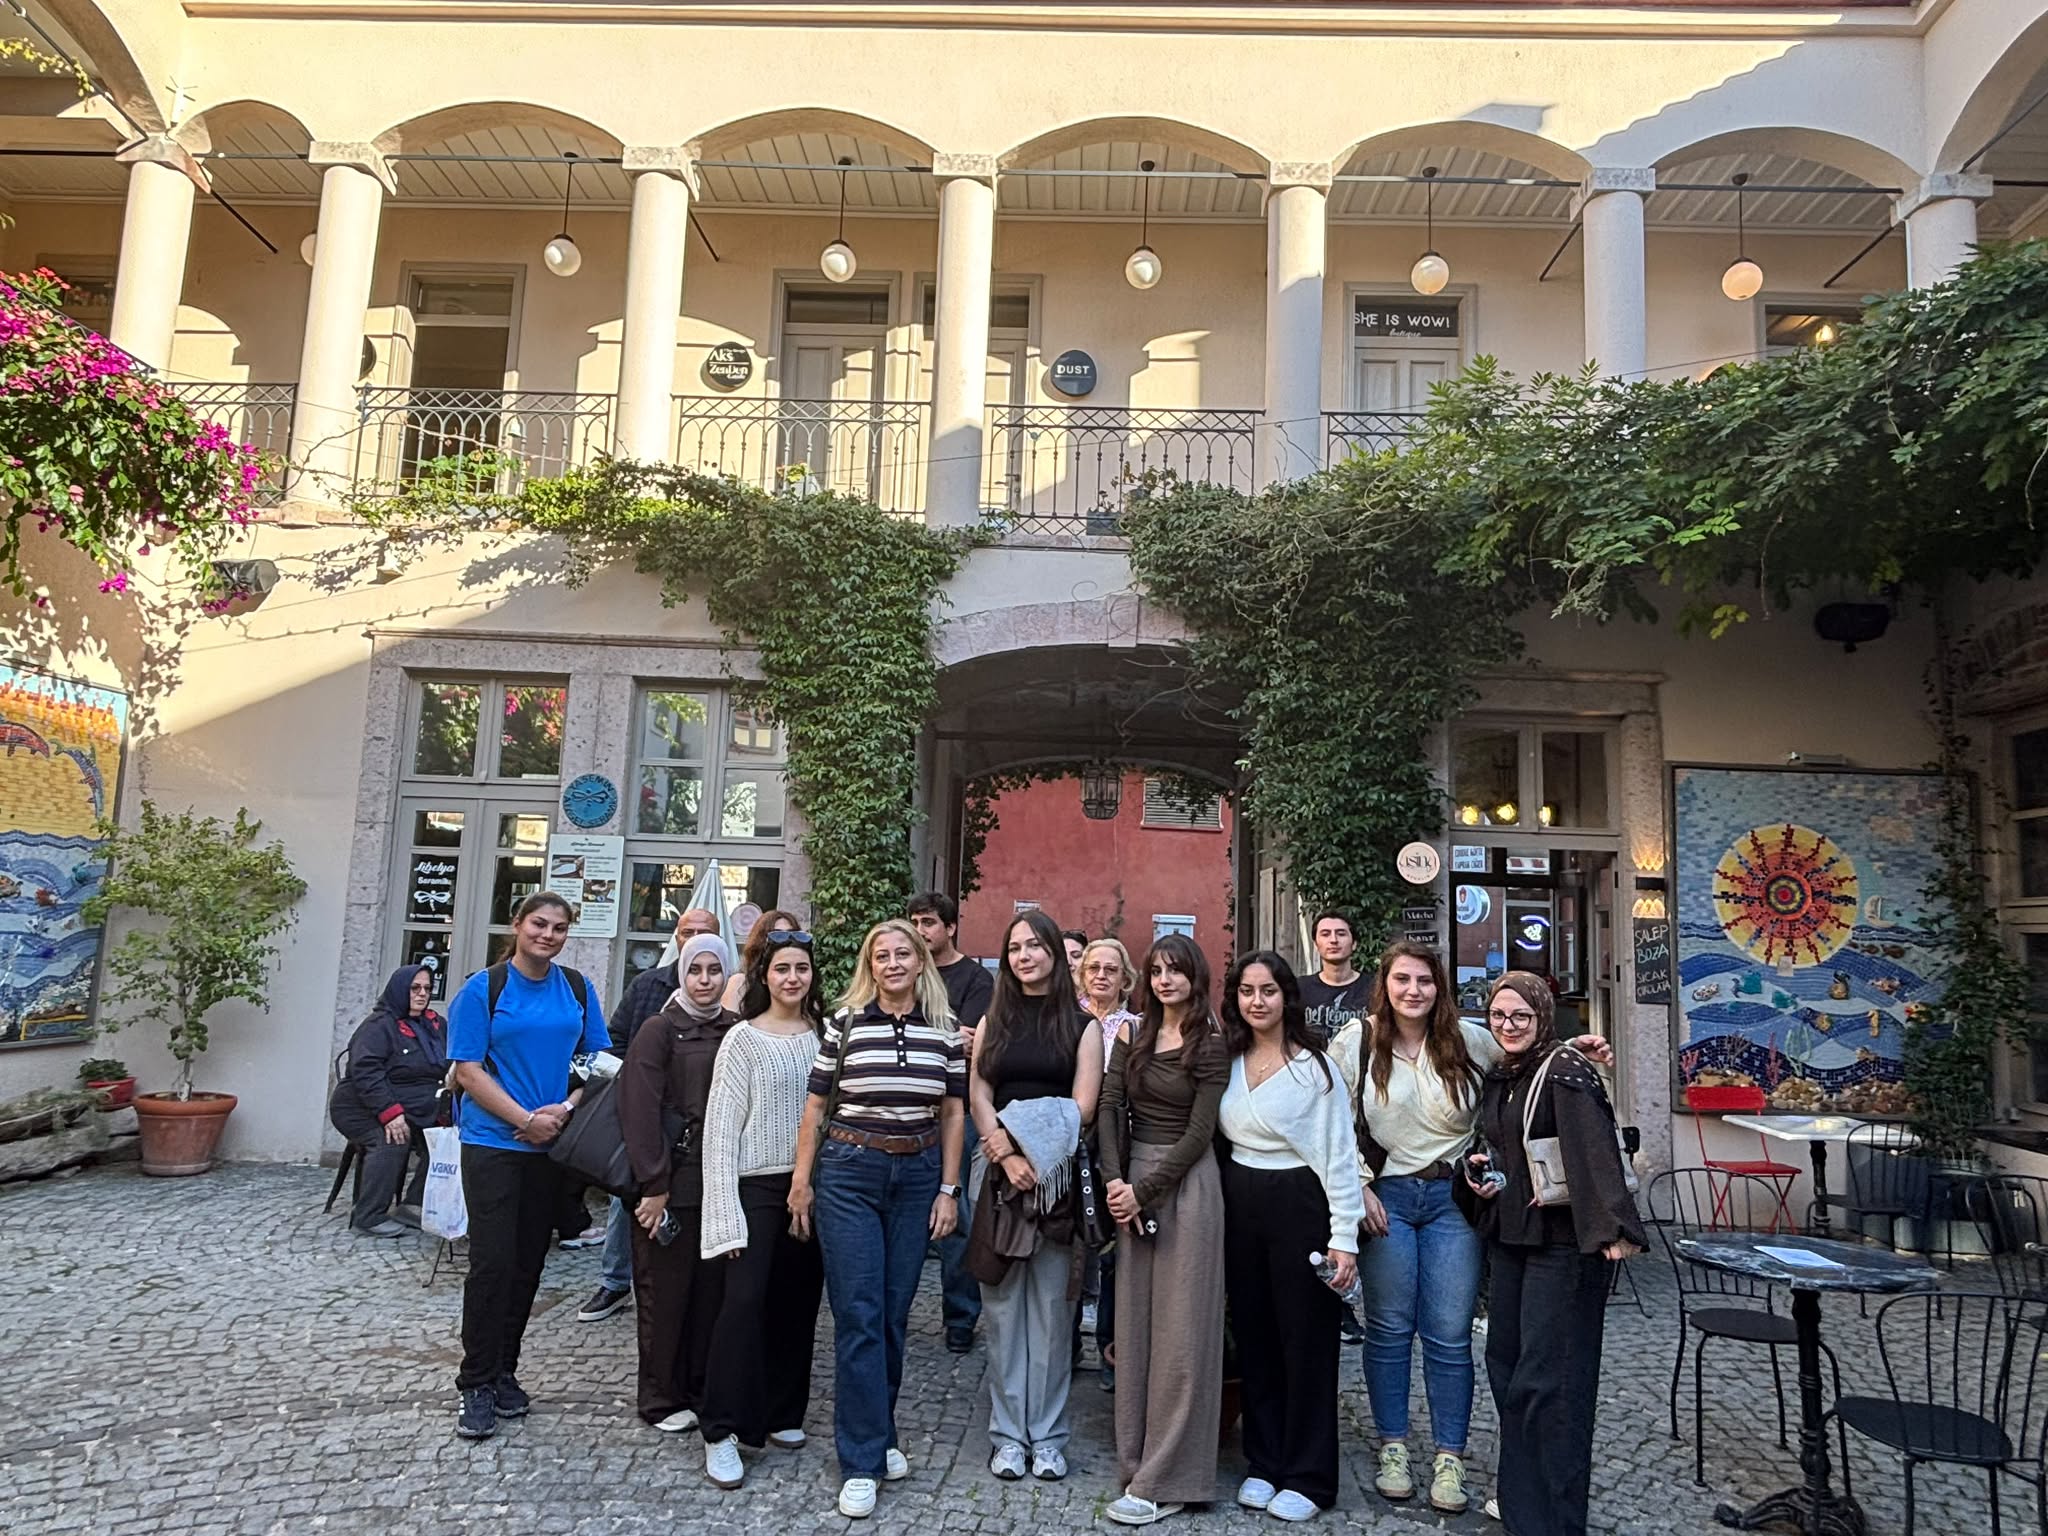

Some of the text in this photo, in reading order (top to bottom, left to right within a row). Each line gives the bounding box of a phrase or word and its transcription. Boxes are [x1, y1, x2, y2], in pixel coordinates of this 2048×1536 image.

[1354, 311, 1379, 328] SHE
[1385, 313, 1400, 326] IS
[1057, 364, 1090, 375] DUST
[1635, 925, 1669, 947] SALEP
[1636, 943, 1669, 964] BOZA
